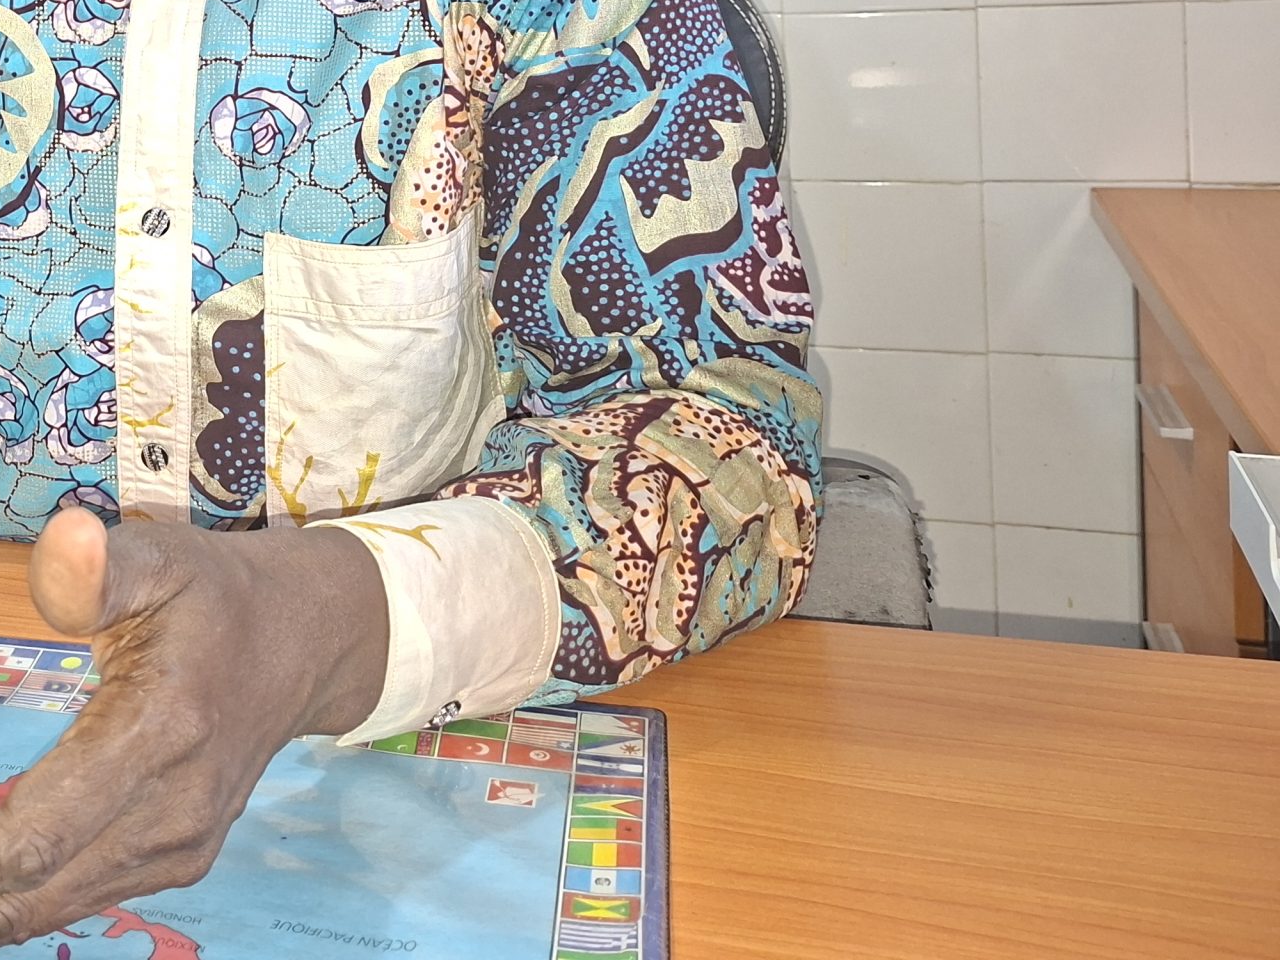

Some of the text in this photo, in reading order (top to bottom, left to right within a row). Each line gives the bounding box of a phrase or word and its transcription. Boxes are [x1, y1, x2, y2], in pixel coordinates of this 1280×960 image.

[132, 907, 203, 926] HONDURAS
[269, 919, 418, 952] OCÉAN PACIFIQUE
